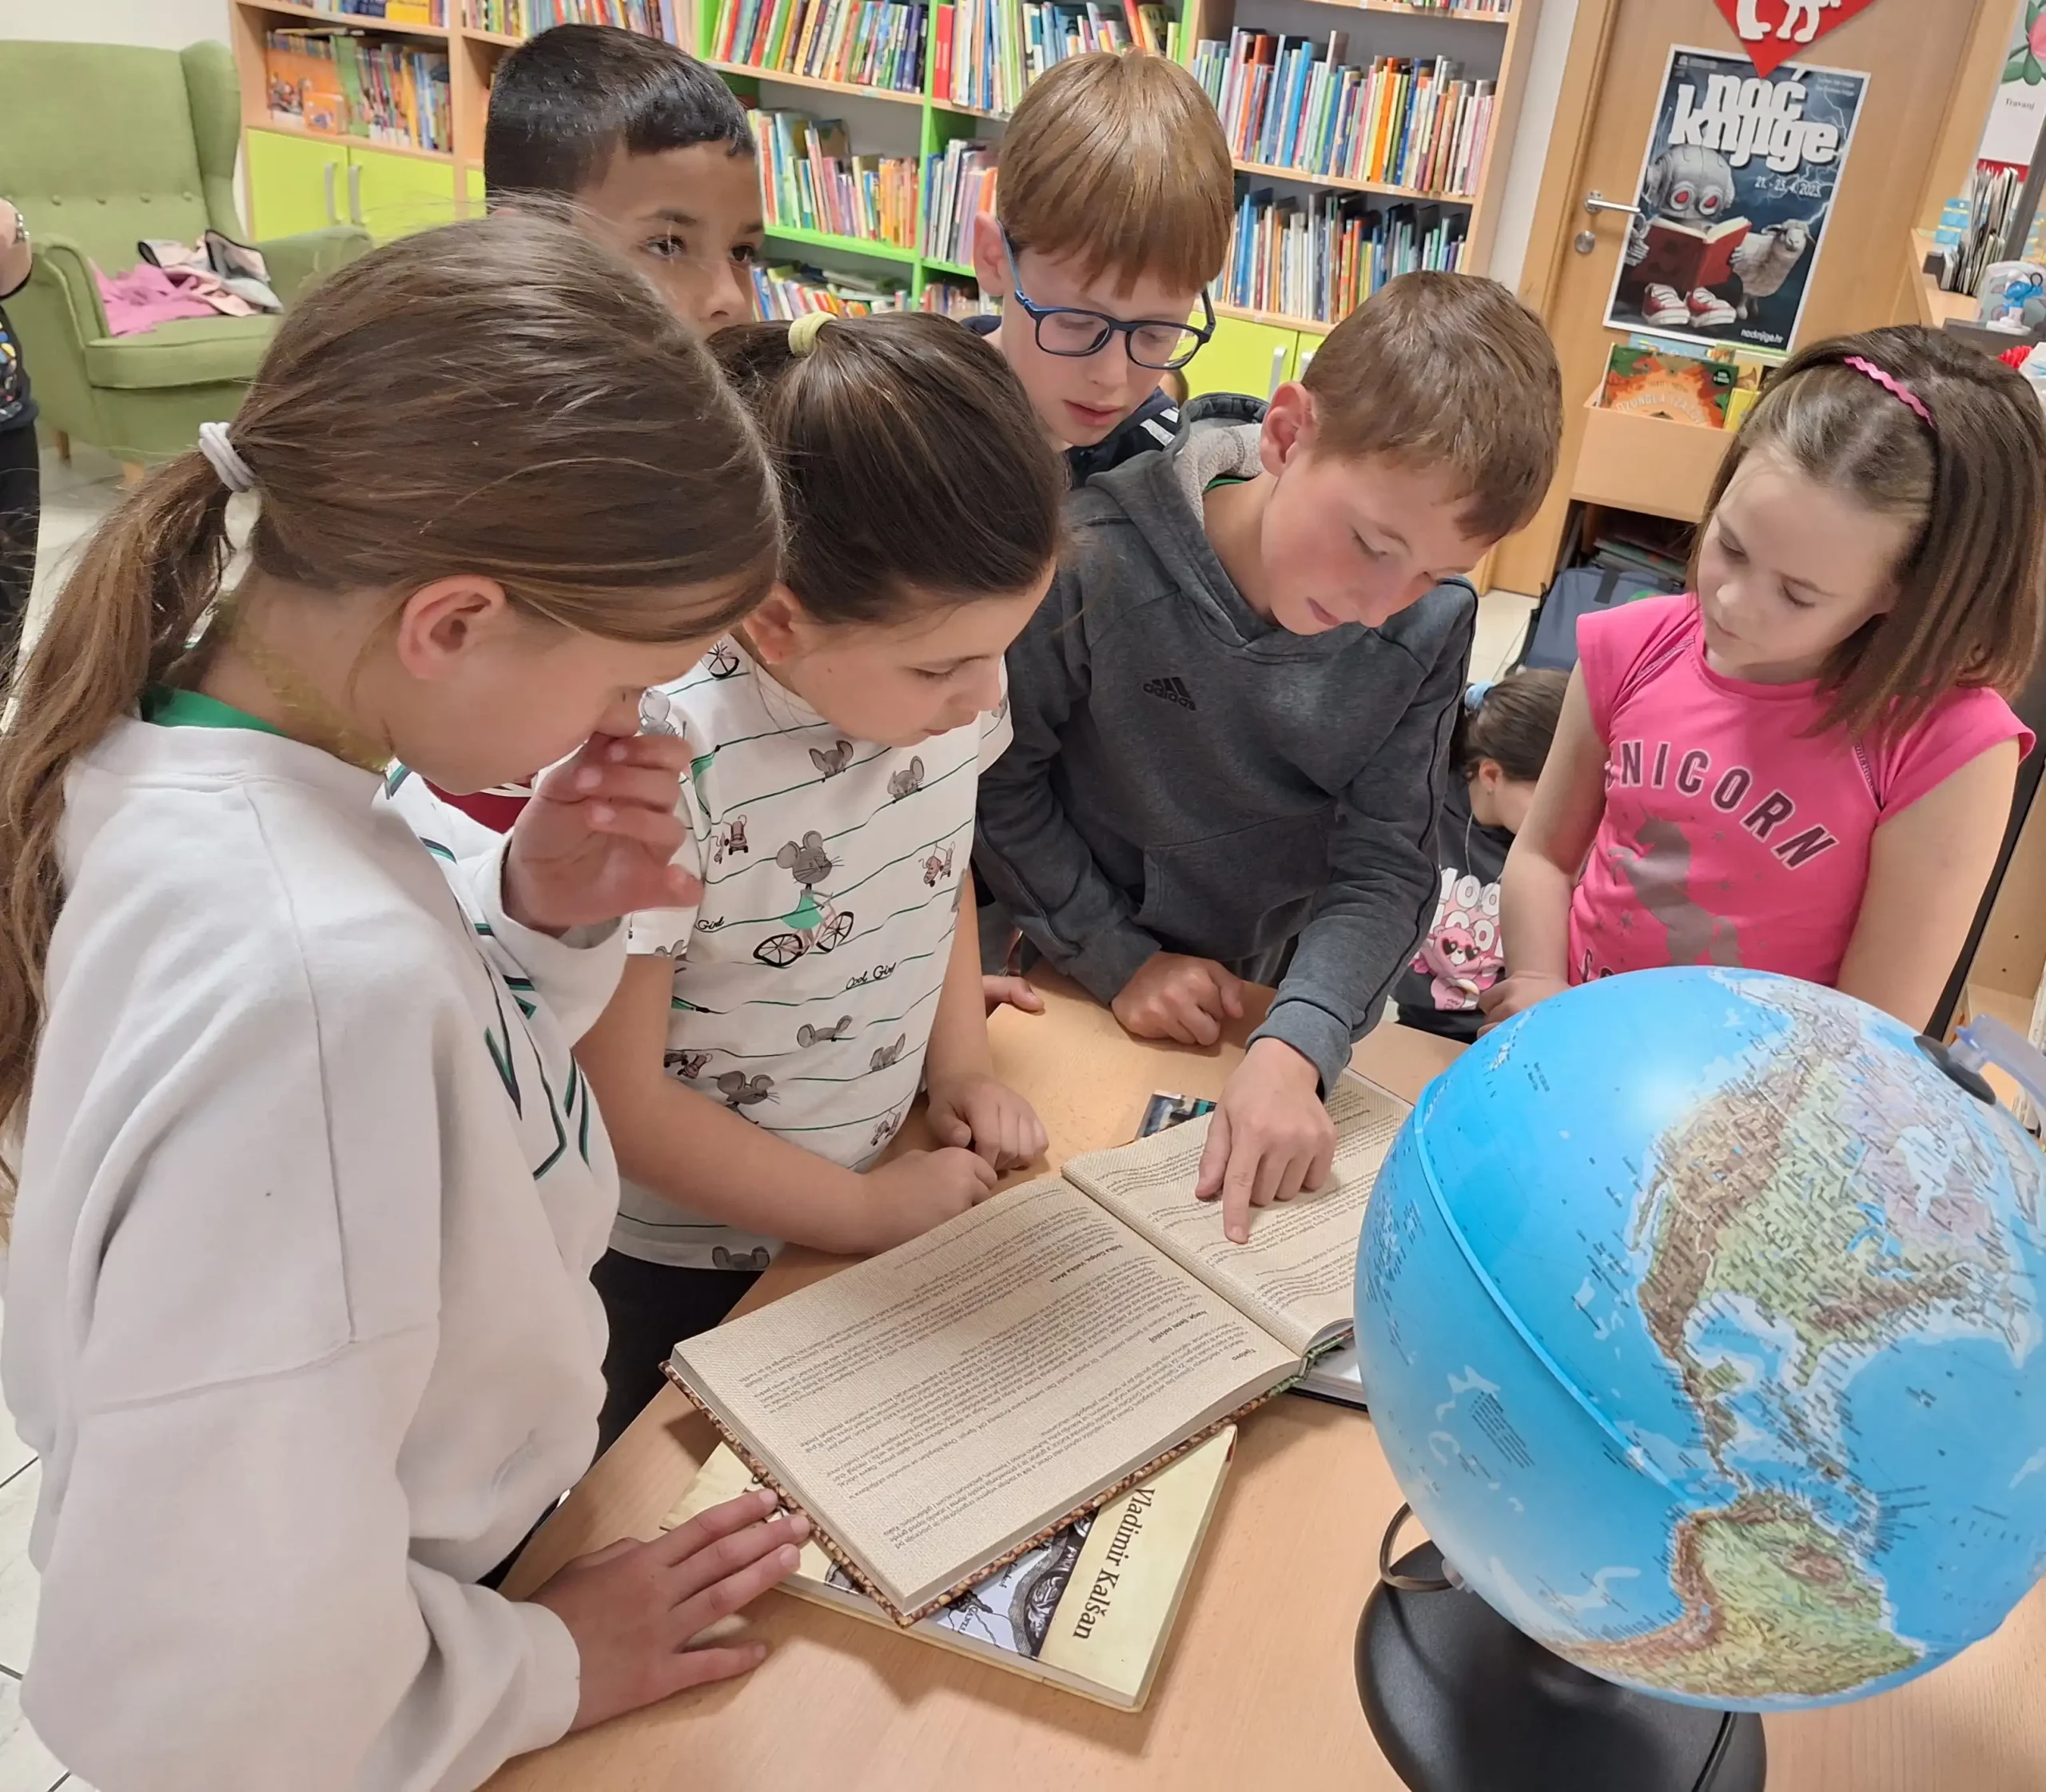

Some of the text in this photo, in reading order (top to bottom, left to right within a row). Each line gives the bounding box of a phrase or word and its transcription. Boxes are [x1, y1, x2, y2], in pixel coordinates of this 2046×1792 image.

[1702, 69, 1807, 121] noć
[1668, 84, 1839, 173] knjige
[697, 916, 725, 930] Girl
[873, 962, 897, 980] Girl
[1073, 1487, 1156, 1639] Vladimir Kalšan
